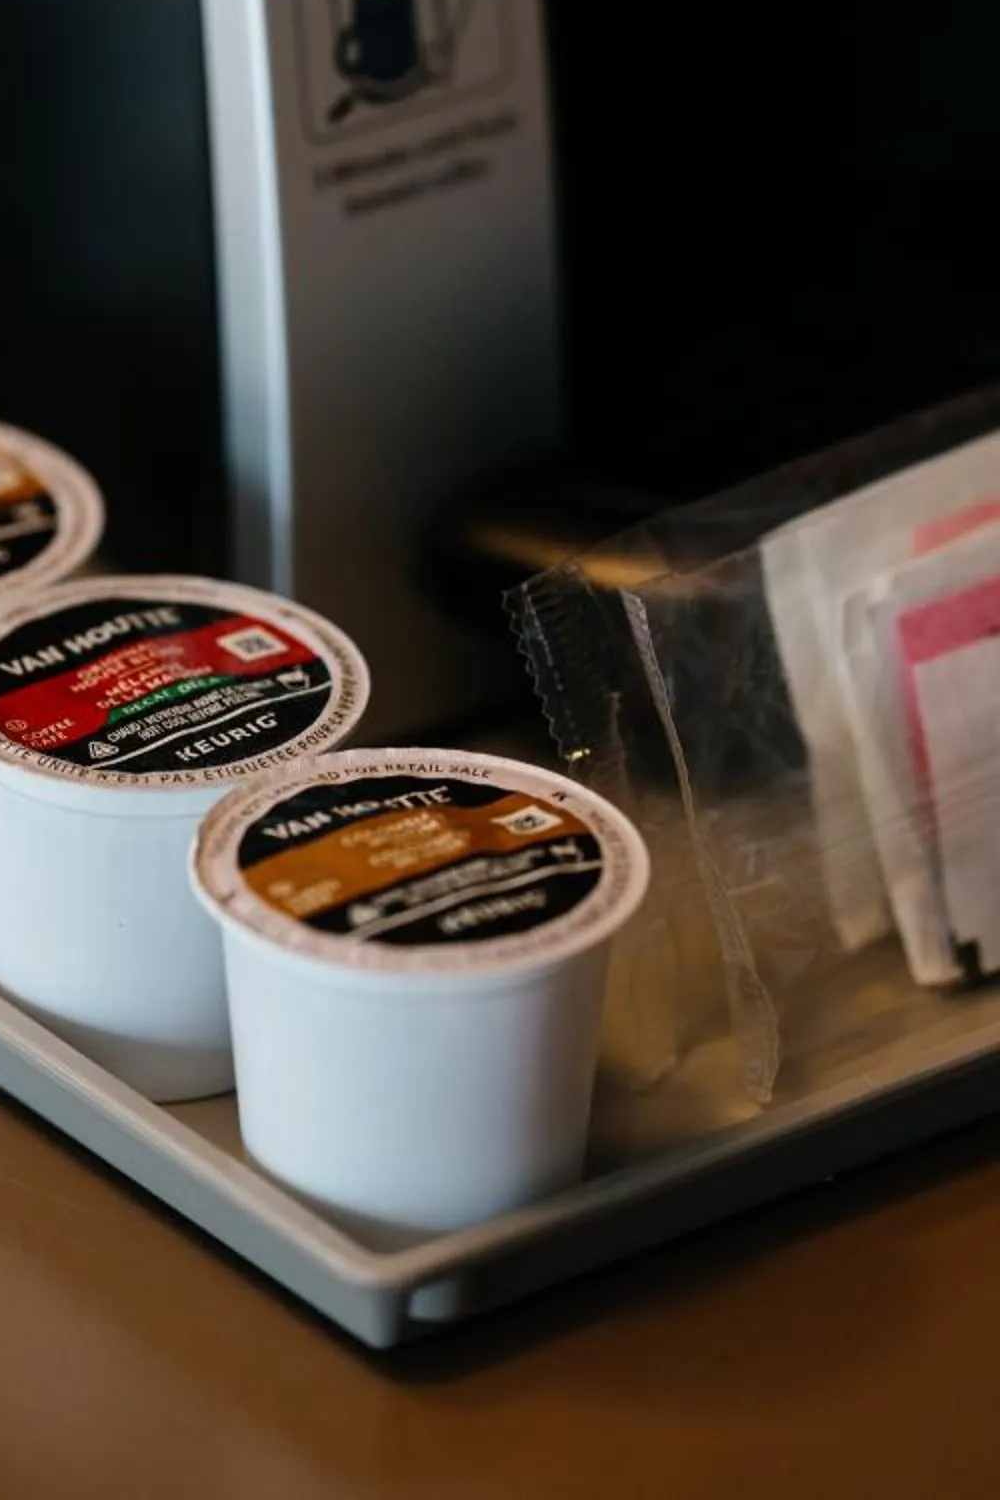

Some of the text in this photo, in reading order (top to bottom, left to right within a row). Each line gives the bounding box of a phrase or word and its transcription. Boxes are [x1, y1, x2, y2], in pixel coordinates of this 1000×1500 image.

[63, 606, 181, 653] HOUTTE
[175, 712, 278, 762] KEURIG
[160, 772, 196, 784] PAS
[262, 809, 333, 840] VAN
